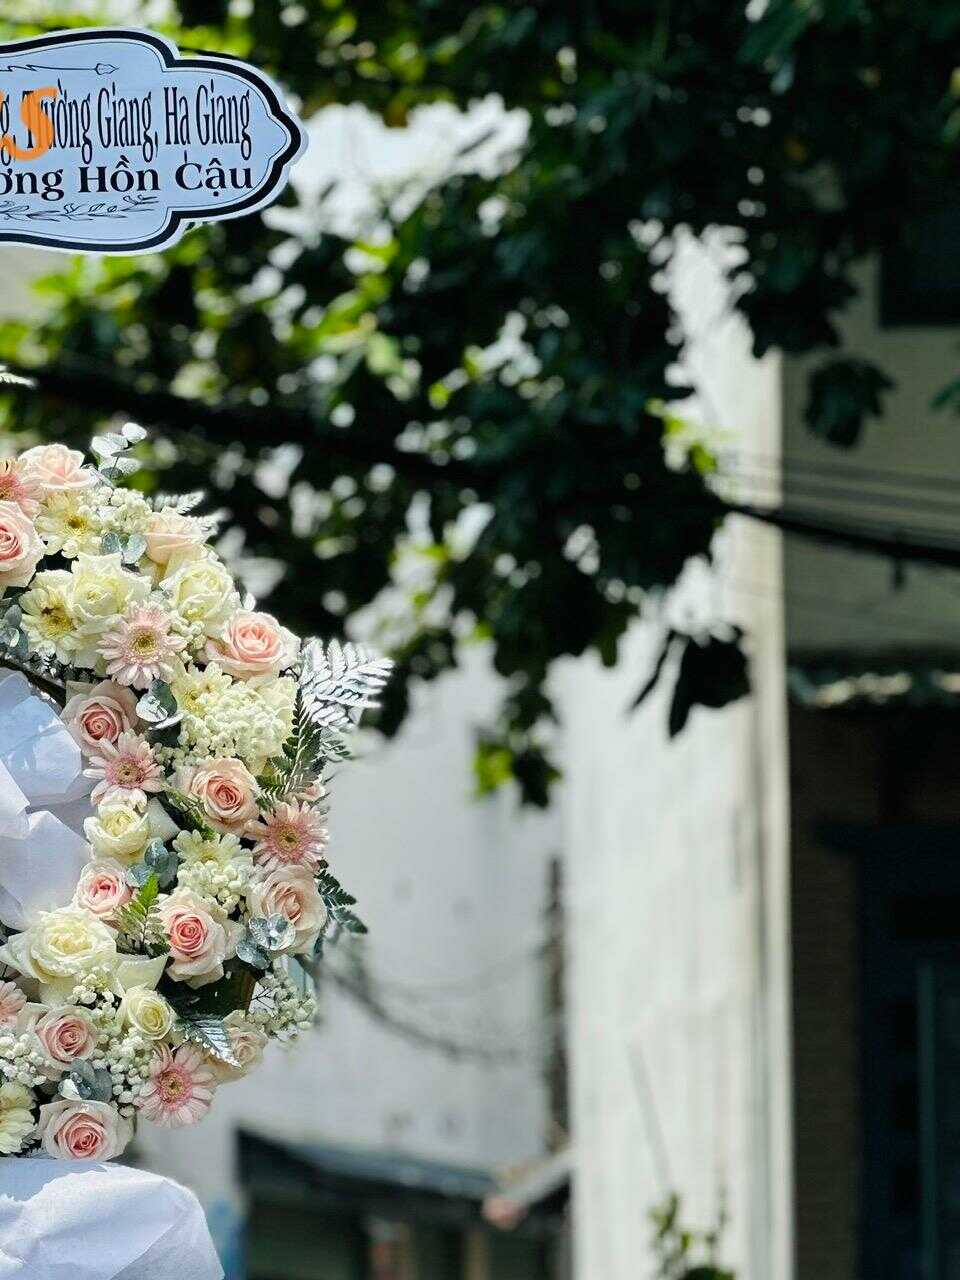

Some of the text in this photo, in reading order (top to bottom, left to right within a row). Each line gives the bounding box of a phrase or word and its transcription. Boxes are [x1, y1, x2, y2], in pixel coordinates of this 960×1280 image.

[97, 81, 159, 162] Giang,
[195, 78, 252, 161] Giang
[77, 154, 161, 193] Hồn
[175, 158, 255, 197] Cậu
